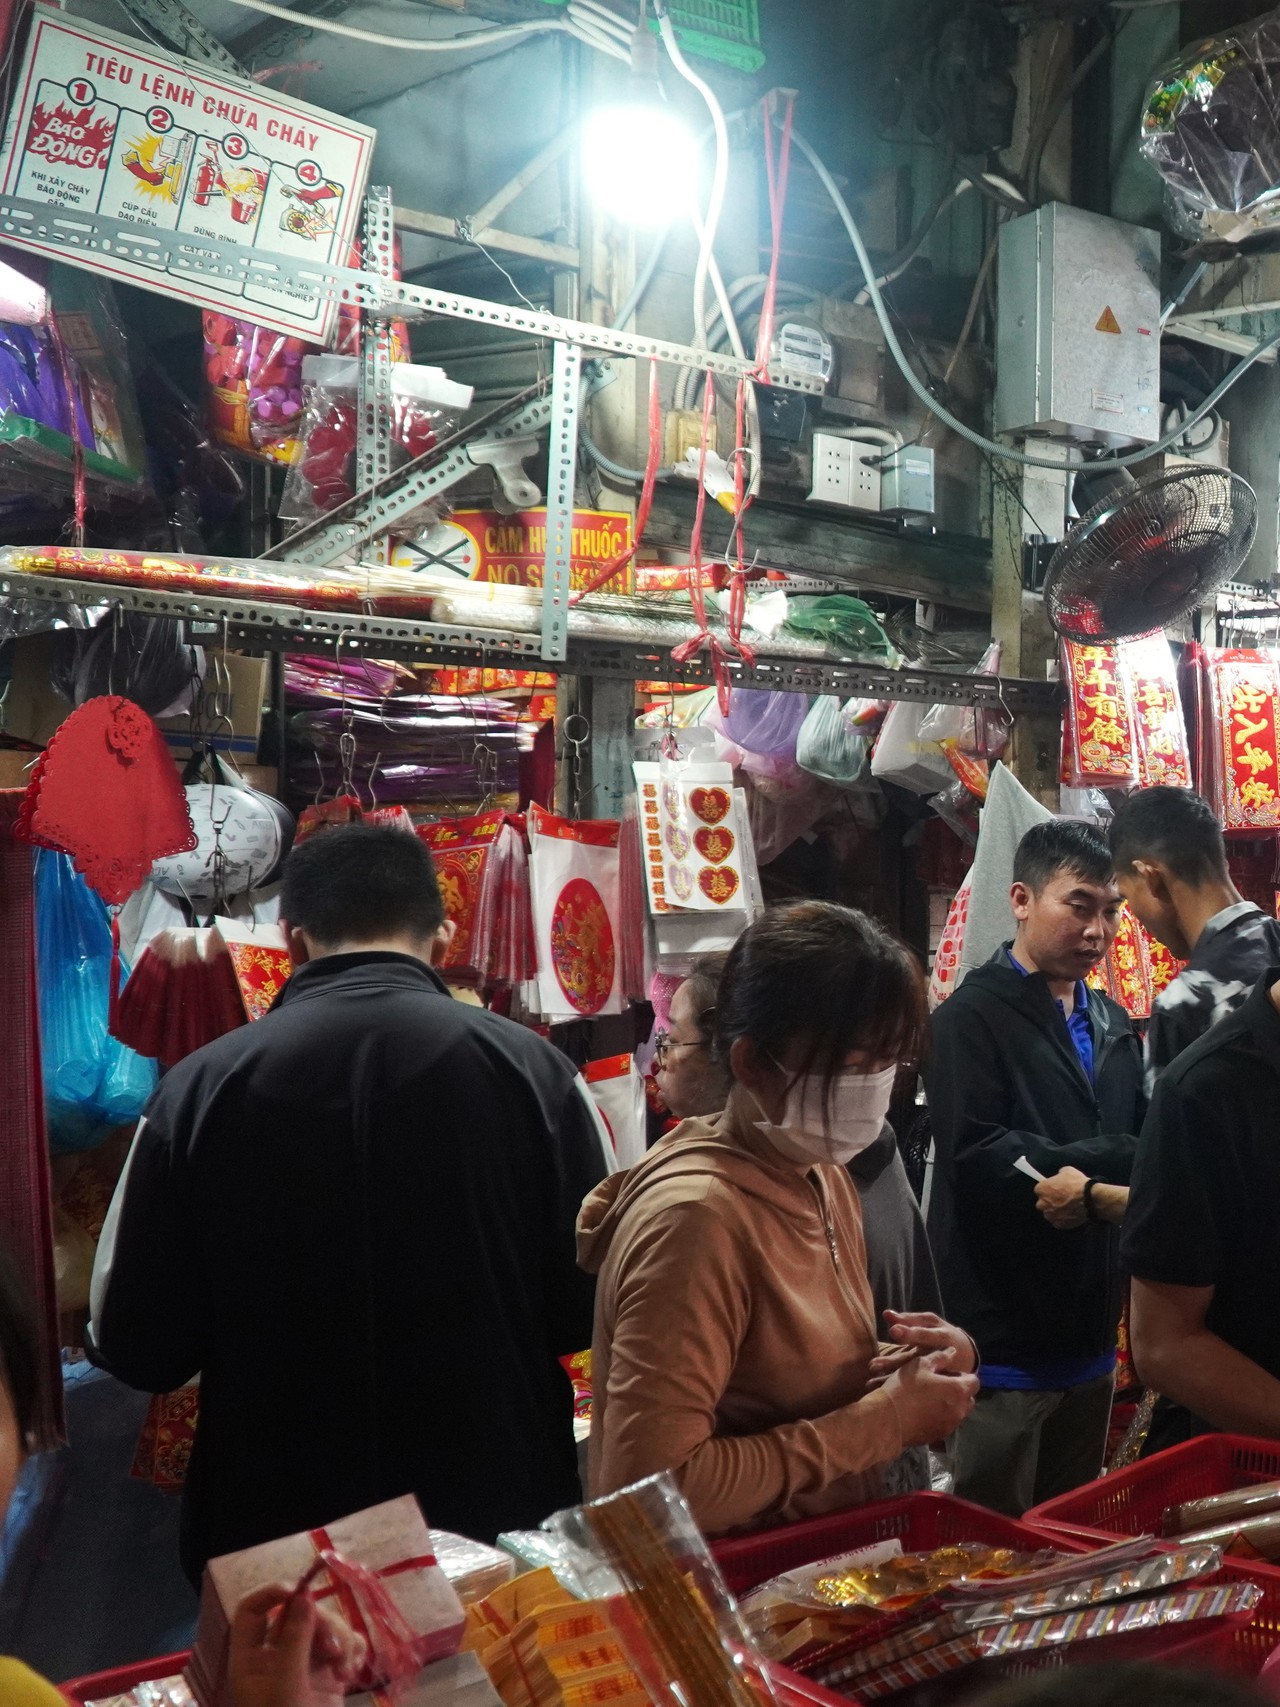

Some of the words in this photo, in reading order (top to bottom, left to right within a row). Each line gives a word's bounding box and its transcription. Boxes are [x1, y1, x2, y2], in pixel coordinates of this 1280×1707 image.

[74, 83, 88, 101] 1
[86, 52, 132, 85] TIÊU
[140, 73, 195, 109] LỆNH
[203, 96, 258, 129] CHỮA
[266, 119, 320, 152] CHÁY
[44, 117, 86, 140] BÁO
[151, 110, 169, 129] 2
[30, 132, 97, 165] ĐỘNG
[227, 136, 244, 156] 3
[31, 170, 47, 182] KHI
[67, 182, 90, 196] CHÁY
[299, 164, 318, 183] 4
